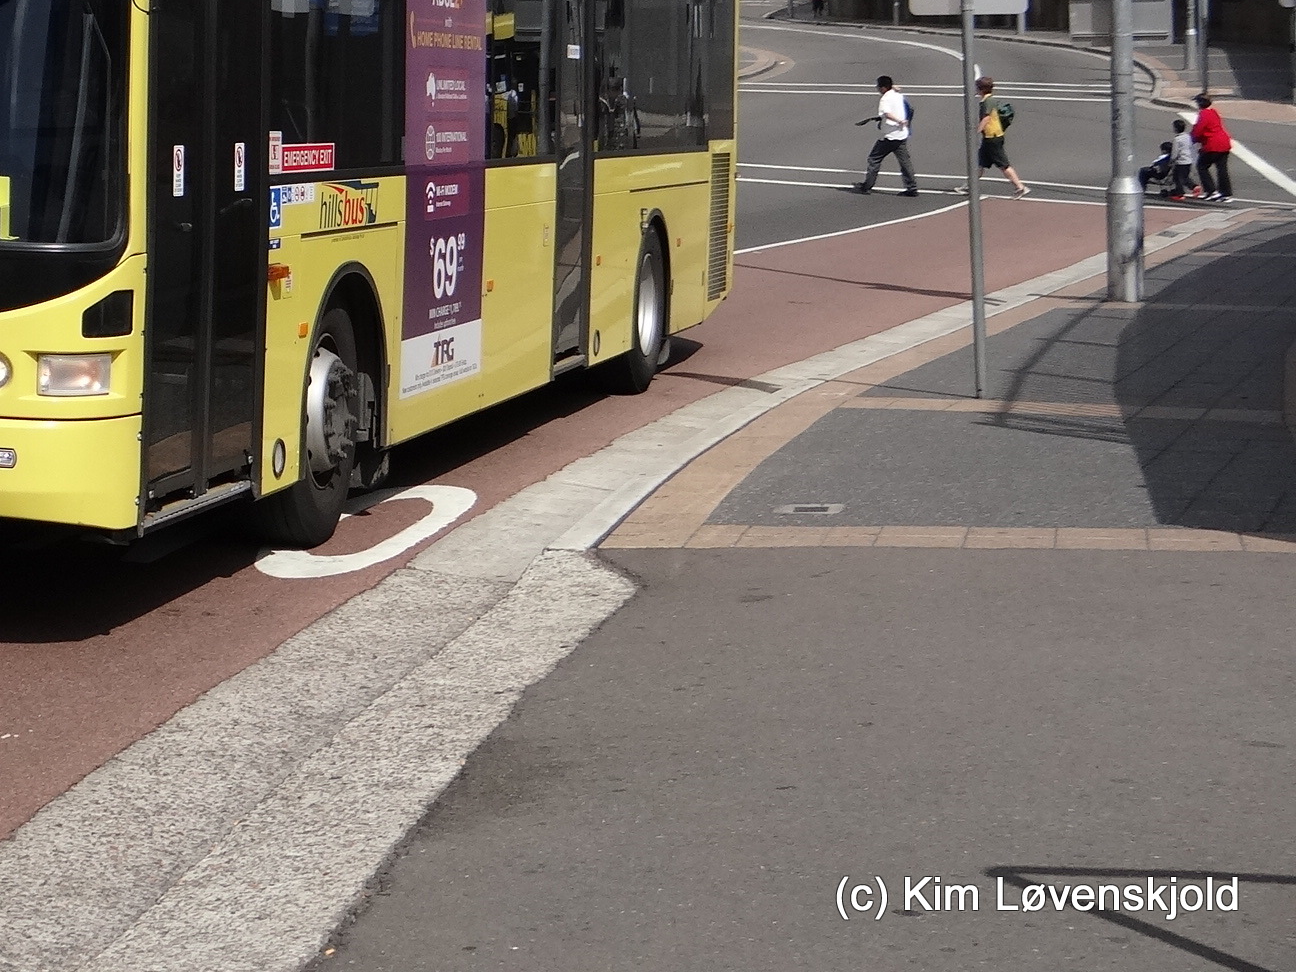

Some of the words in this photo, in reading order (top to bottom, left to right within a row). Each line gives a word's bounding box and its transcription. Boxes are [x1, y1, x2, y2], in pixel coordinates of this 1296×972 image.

[417, 31, 433, 47] HOME
[434, 32, 452, 48] PHONE
[464, 35, 483, 50] RENTAL
[283, 151, 319, 167] EMERGENCY
[319, 149, 333, 165] EXIT
[319, 190, 366, 229] hillsbus
